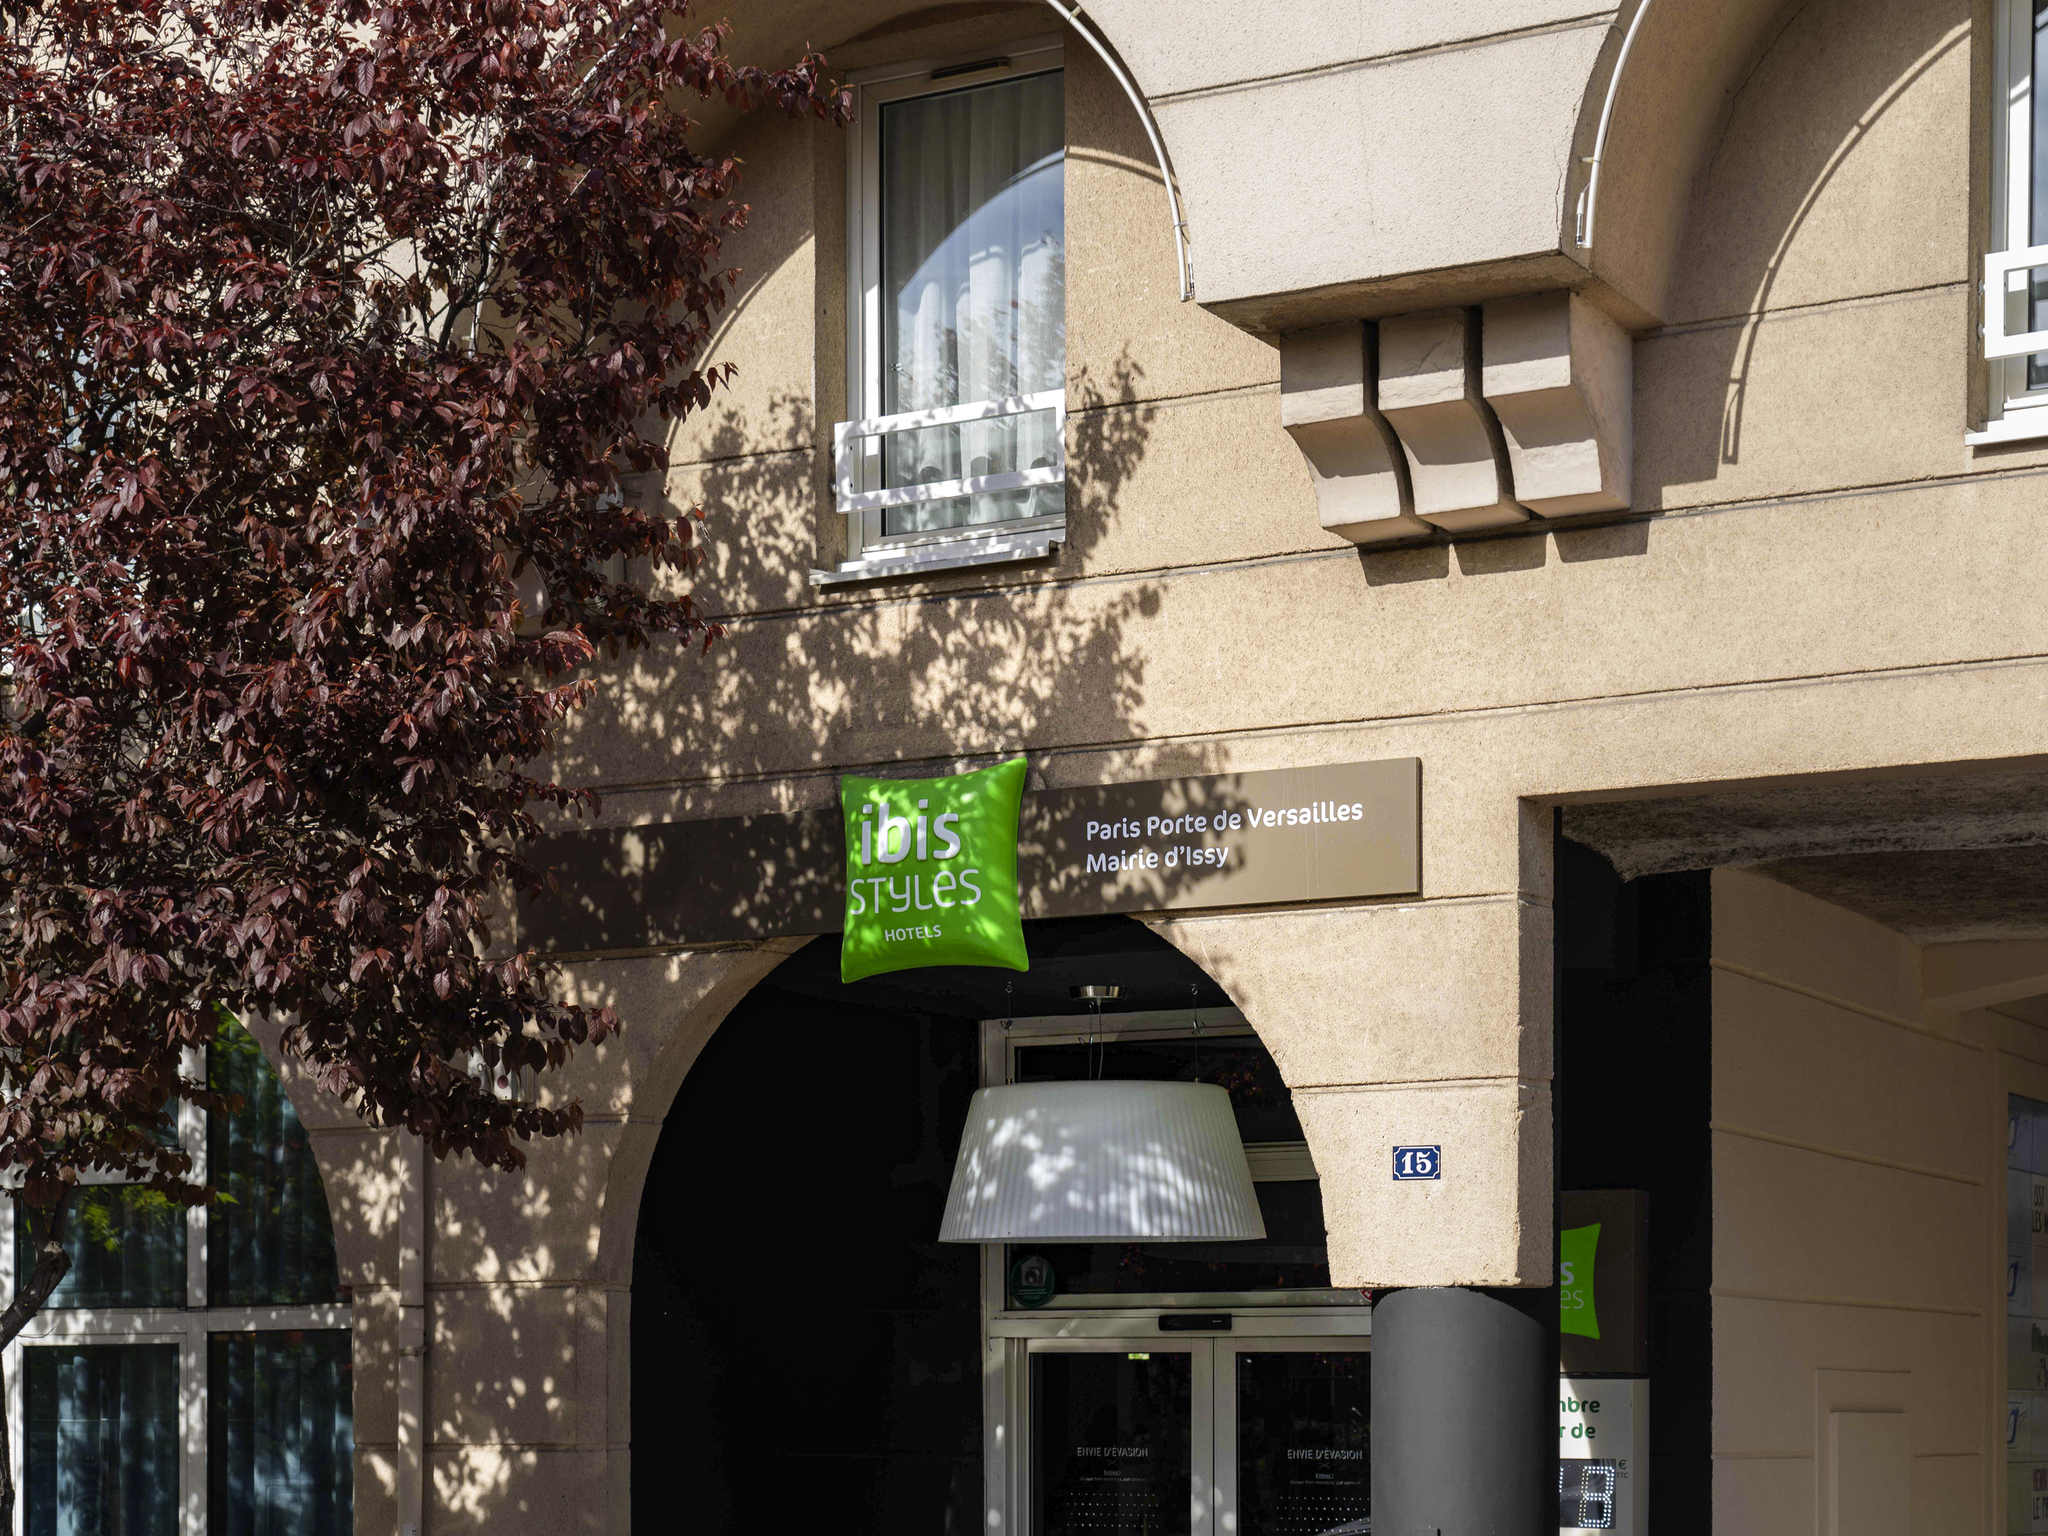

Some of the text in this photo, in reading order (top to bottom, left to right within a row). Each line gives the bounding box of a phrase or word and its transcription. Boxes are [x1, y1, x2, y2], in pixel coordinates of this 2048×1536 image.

[861, 798, 961, 865] ibis
[1086, 800, 1364, 841] Paris Porte de Versailles
[1086, 845, 1229, 873] Mairie d’Issy
[884, 924, 942, 942] HOTELS
[1401, 1151, 1432, 1174] 15
[1571, 1422, 1597, 1440] de
